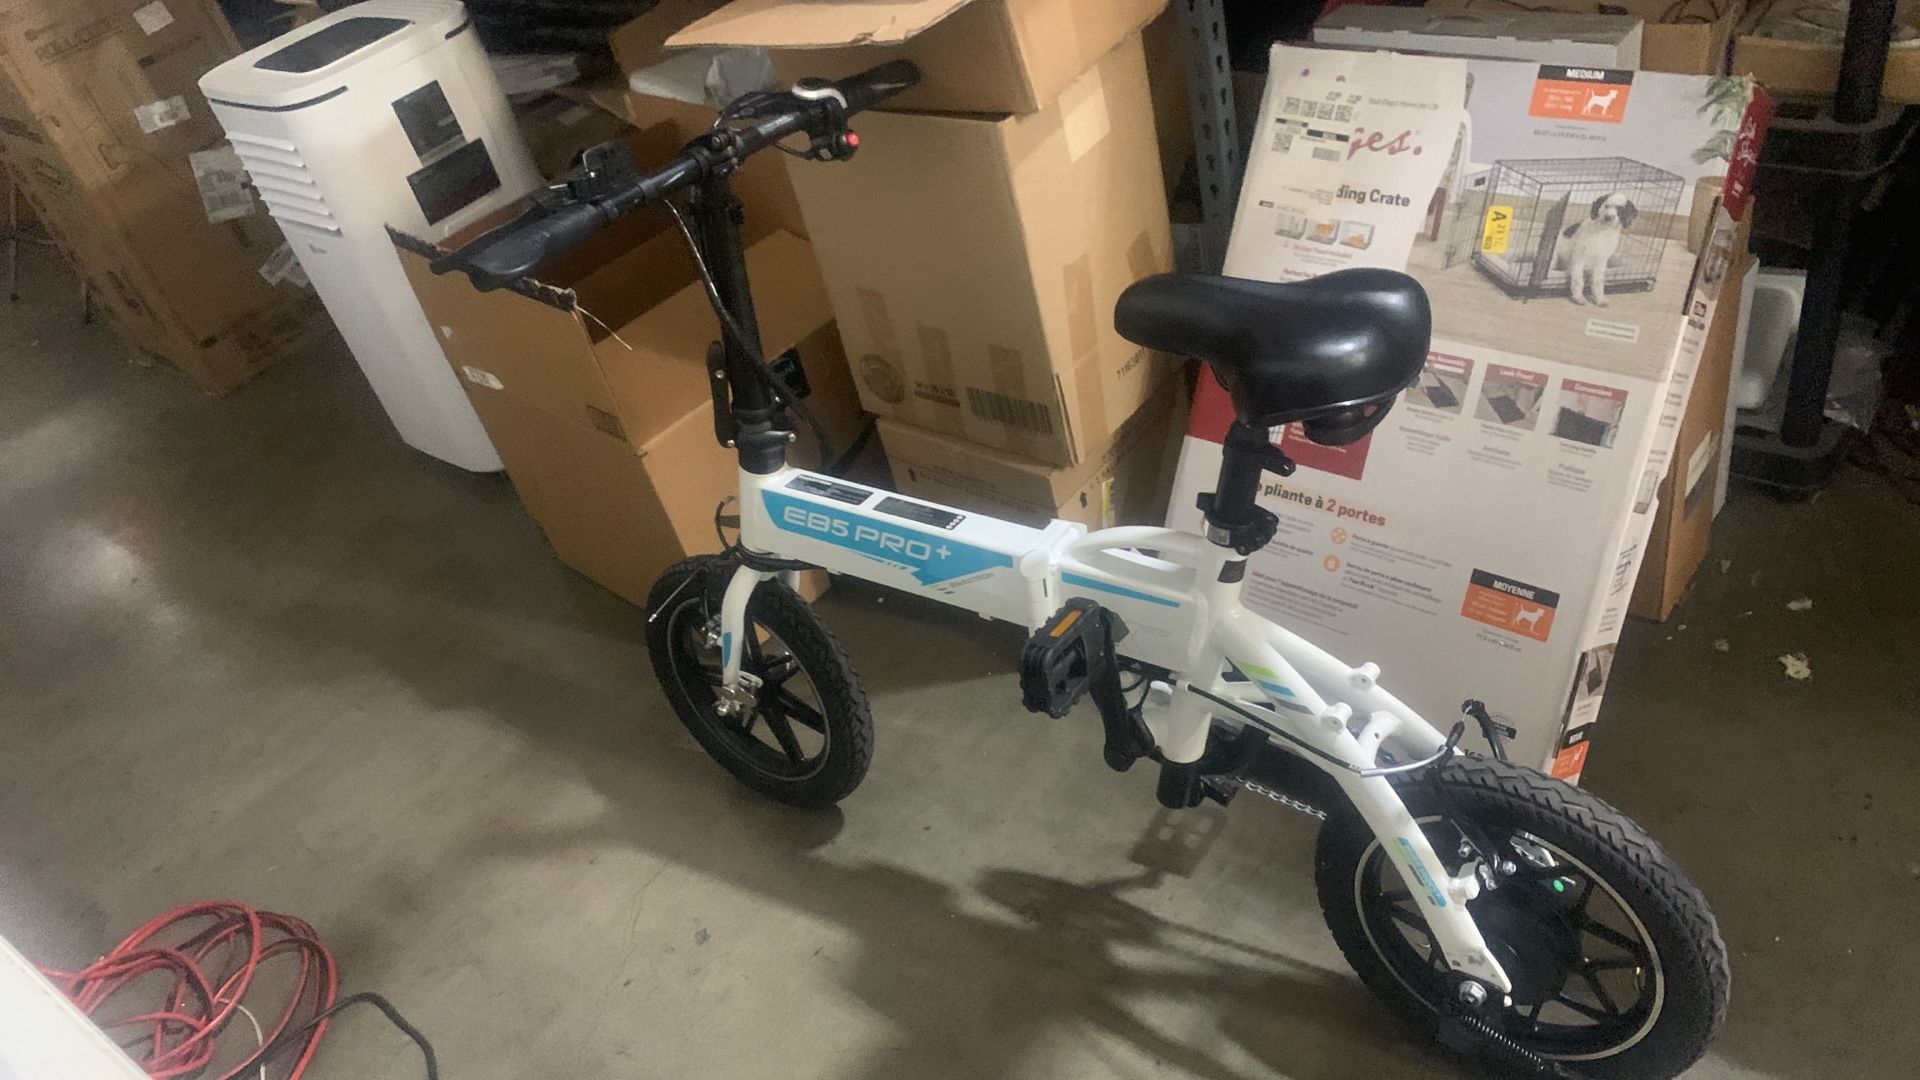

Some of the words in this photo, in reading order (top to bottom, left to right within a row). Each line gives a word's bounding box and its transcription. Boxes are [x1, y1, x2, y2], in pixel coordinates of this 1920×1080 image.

[1565, 68, 1605, 80] MEDIUM
[1369, 189, 1411, 208] Crate
[1491, 210, 1507, 222] A
[1264, 482, 1313, 507] pliante
[1315, 496, 1325, 509] à
[1326, 498, 1337, 512] 2
[1337, 504, 1386, 526] portes
[783, 505, 849, 538] EB5
[1493, 580, 1536, 600] MOYENNE
